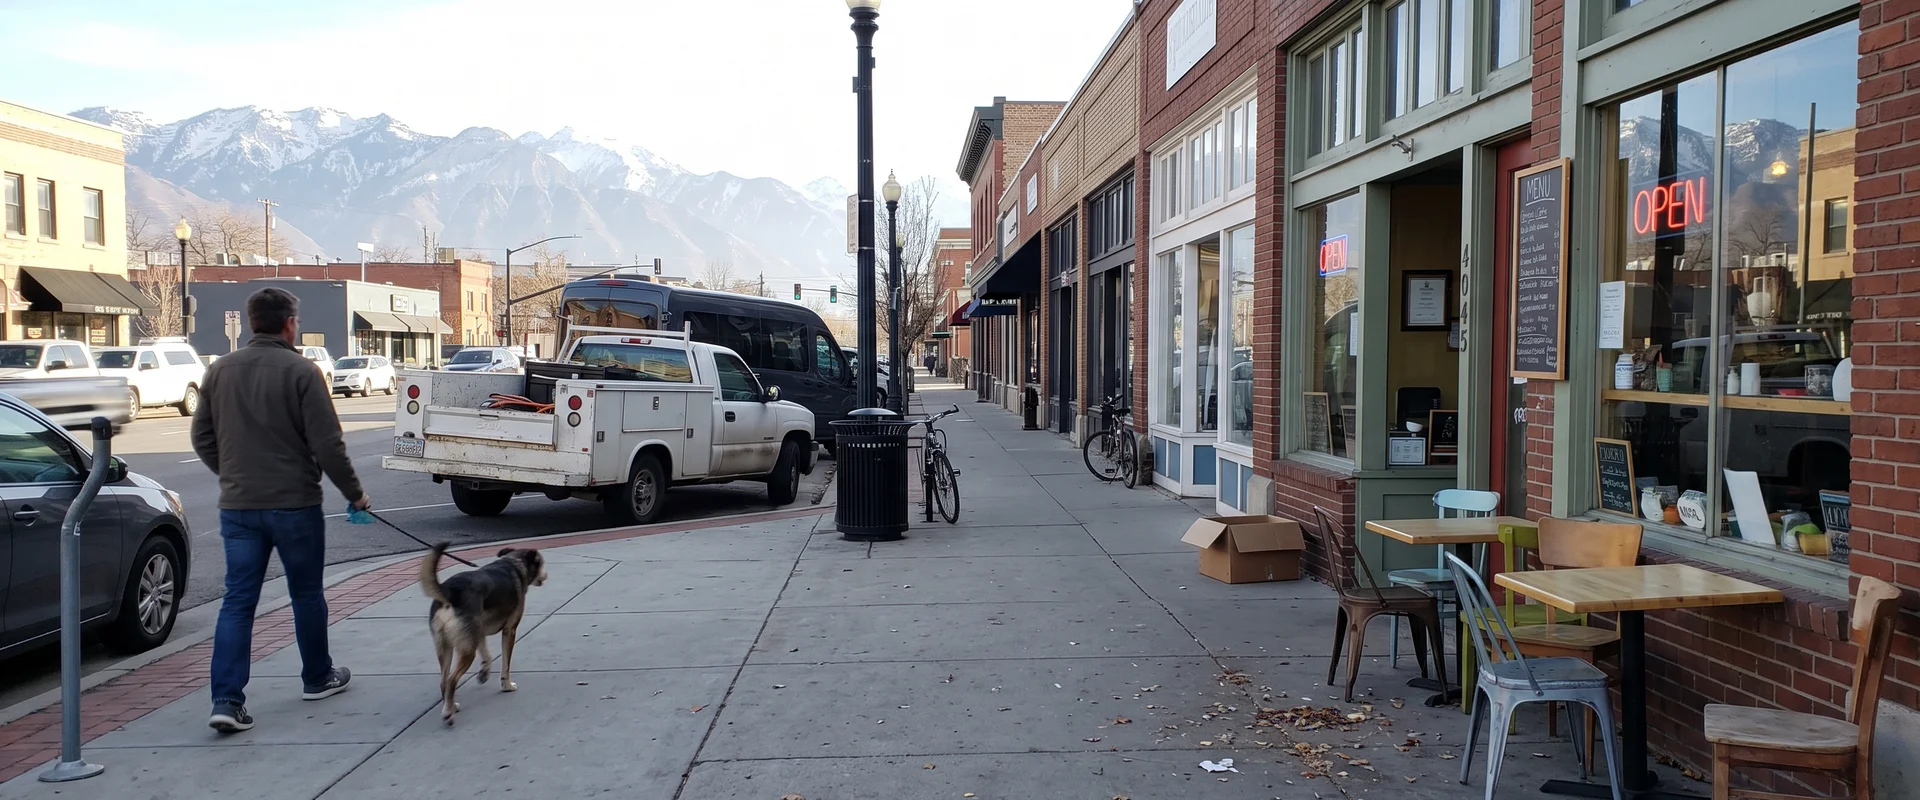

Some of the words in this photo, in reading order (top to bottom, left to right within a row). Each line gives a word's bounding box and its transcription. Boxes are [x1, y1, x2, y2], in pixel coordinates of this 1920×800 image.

[1526, 174, 1551, 202] MENU
[1634, 176, 1705, 234] OPEN
[1320, 239, 1345, 272] OPEN
[1460, 243, 1470, 352] 4045
